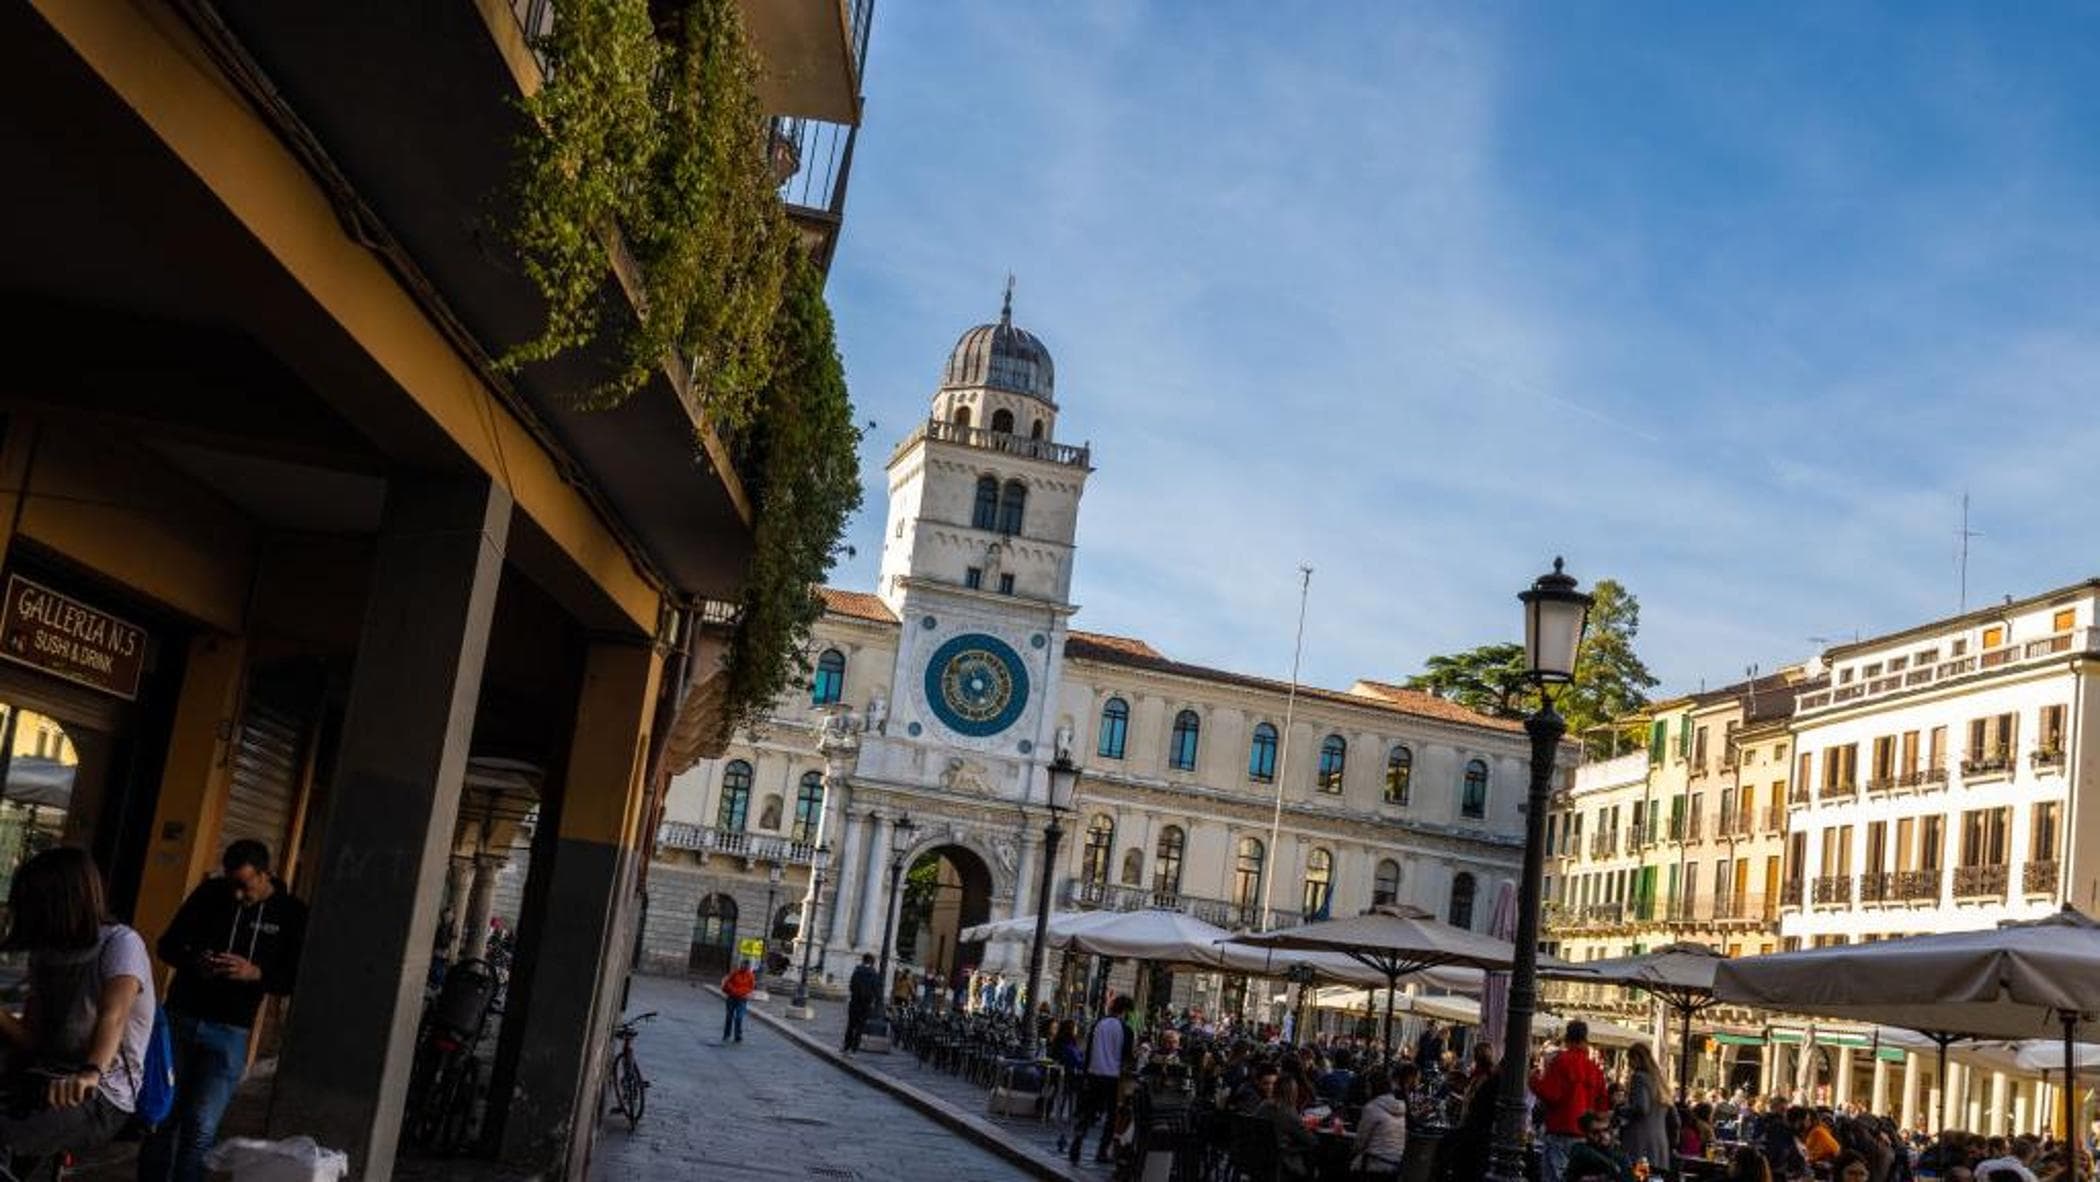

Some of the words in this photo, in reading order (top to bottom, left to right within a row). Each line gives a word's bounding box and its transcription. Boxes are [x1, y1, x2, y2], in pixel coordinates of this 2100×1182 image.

[18, 589, 106, 645] GALLERIA
[34, 630, 70, 659] SUSHI
[80, 648, 114, 673] DRINK
